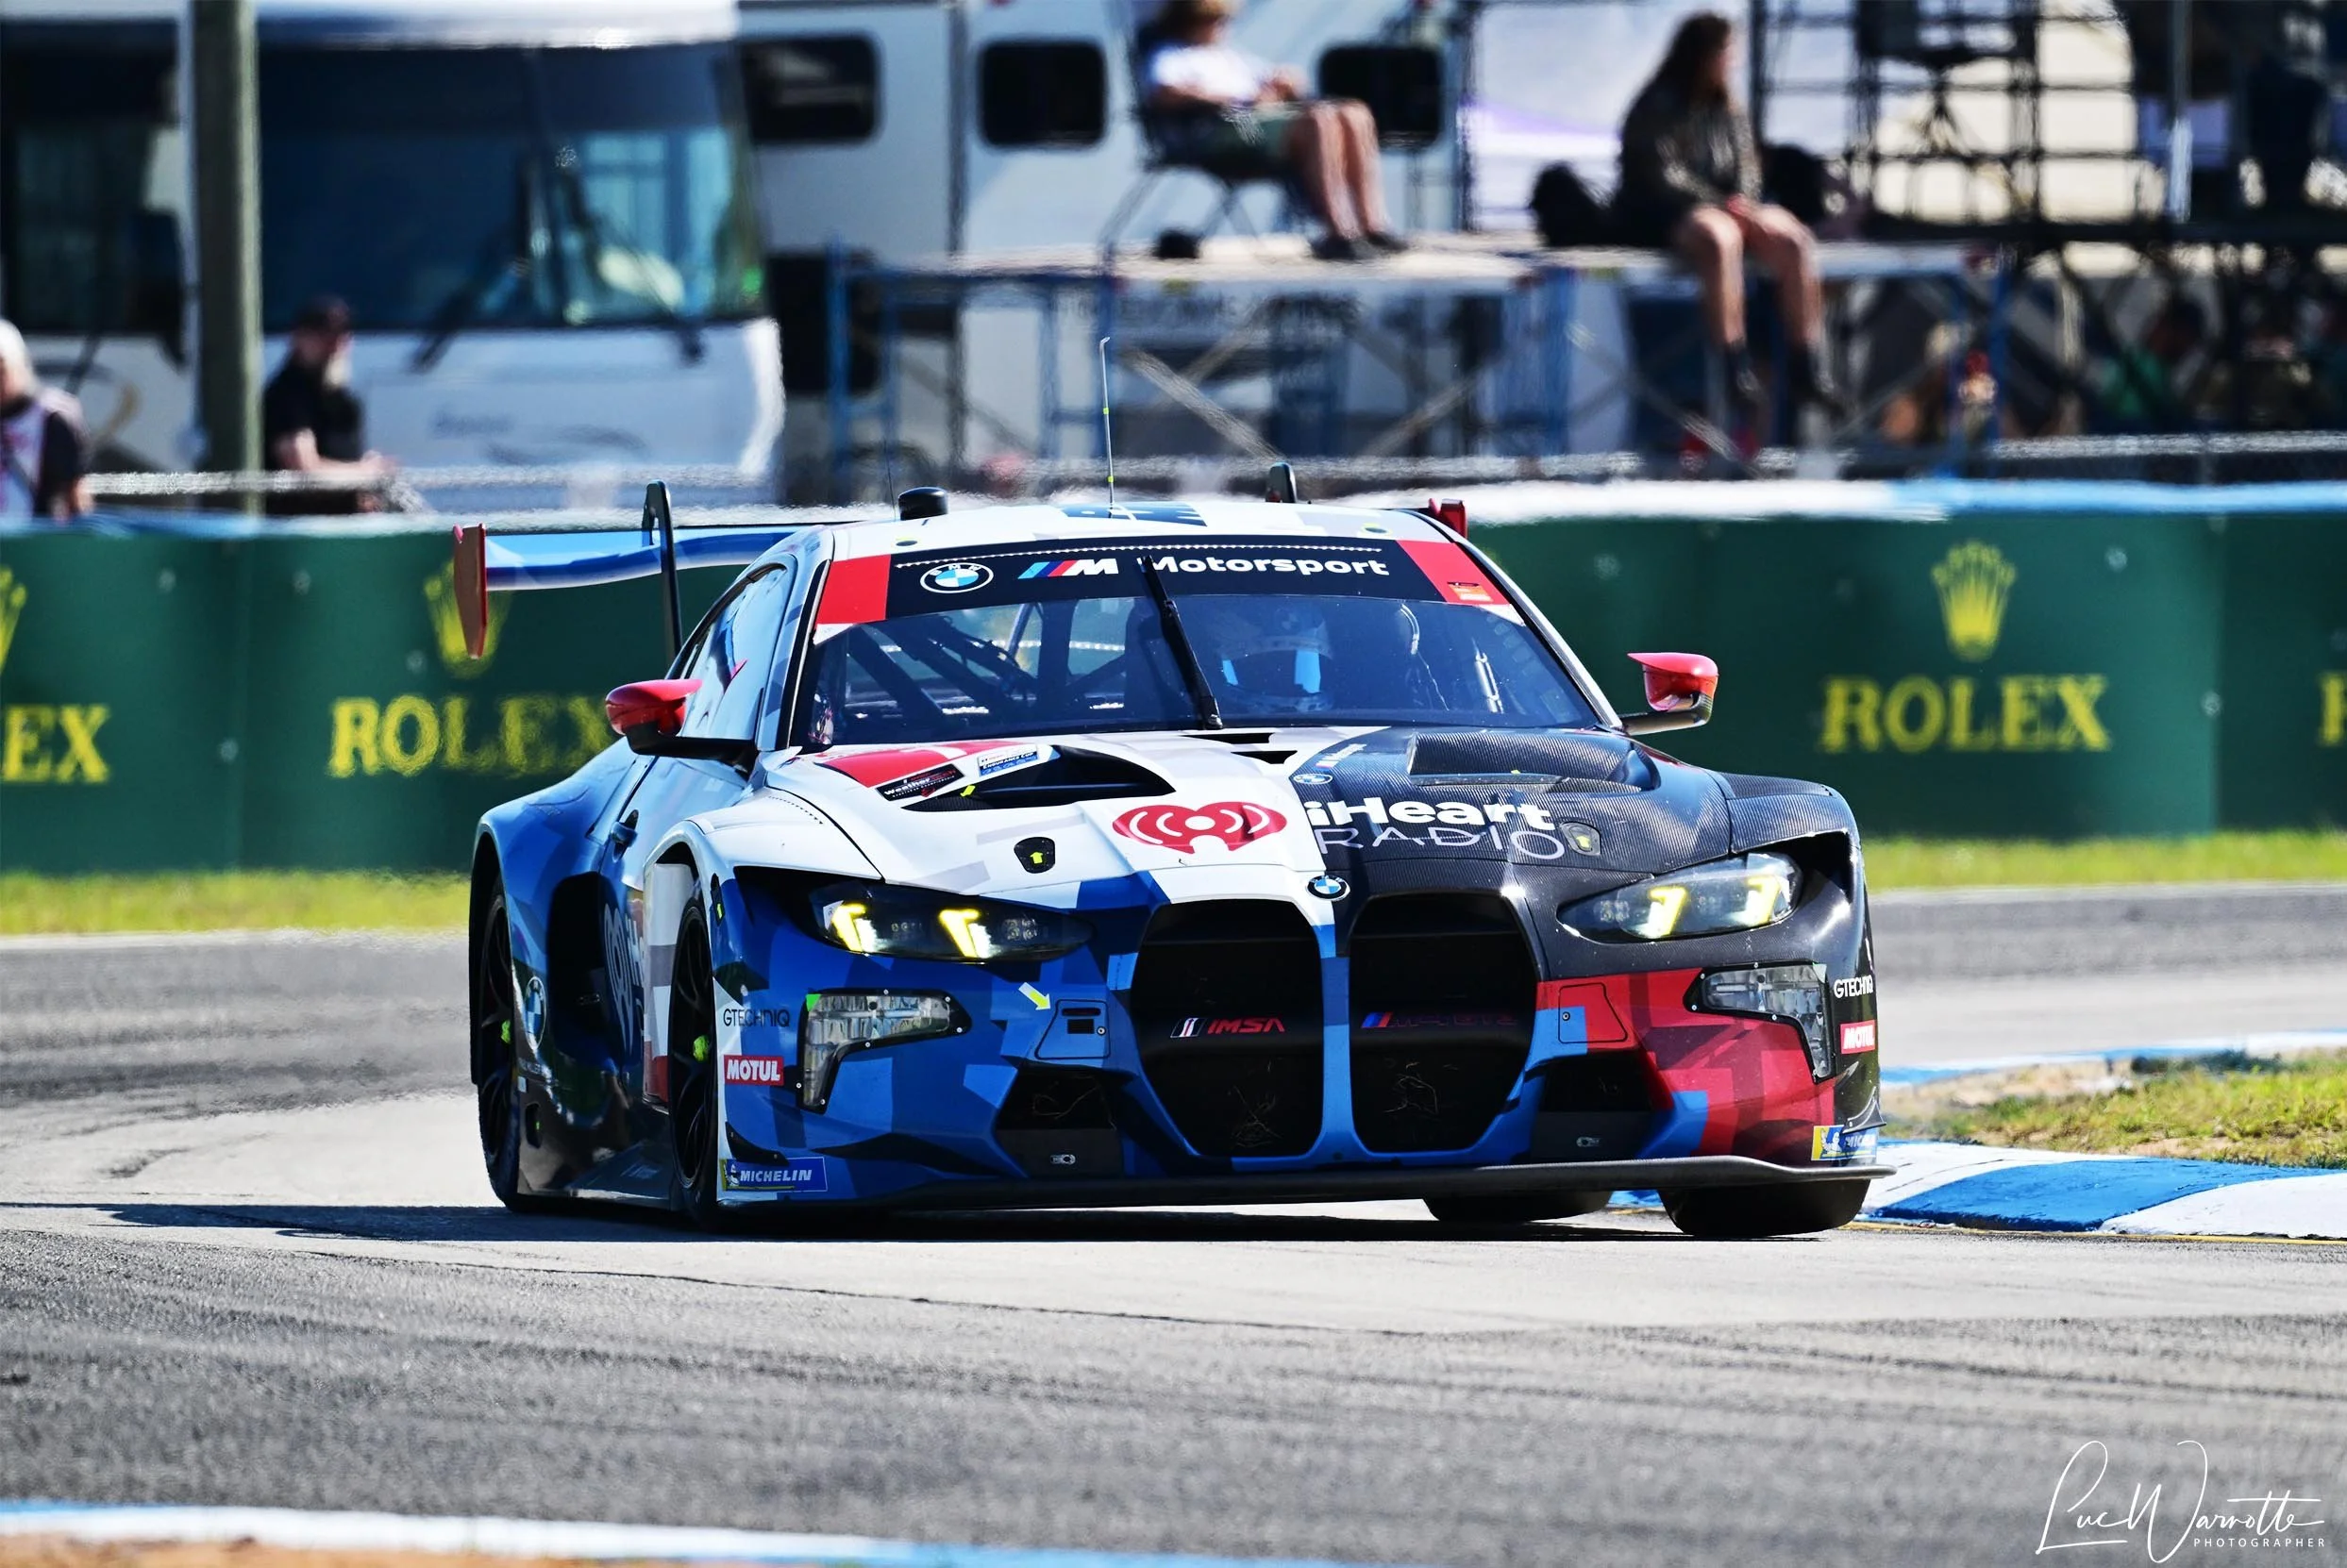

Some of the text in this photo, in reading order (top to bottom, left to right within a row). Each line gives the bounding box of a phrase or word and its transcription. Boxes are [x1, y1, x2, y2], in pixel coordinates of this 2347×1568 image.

[1137, 555, 1390, 576] Motorsport
[1822, 675, 2111, 752] ROLEX
[2, 704, 110, 783] EX
[1303, 797, 1556, 830] iHeart
[1313, 826, 1565, 859] RADIO
[1208, 1018, 1285, 1034] IMSA
[727, 1059, 781, 1081] MOTUL
[740, 1169, 813, 1182] MICHELIN
